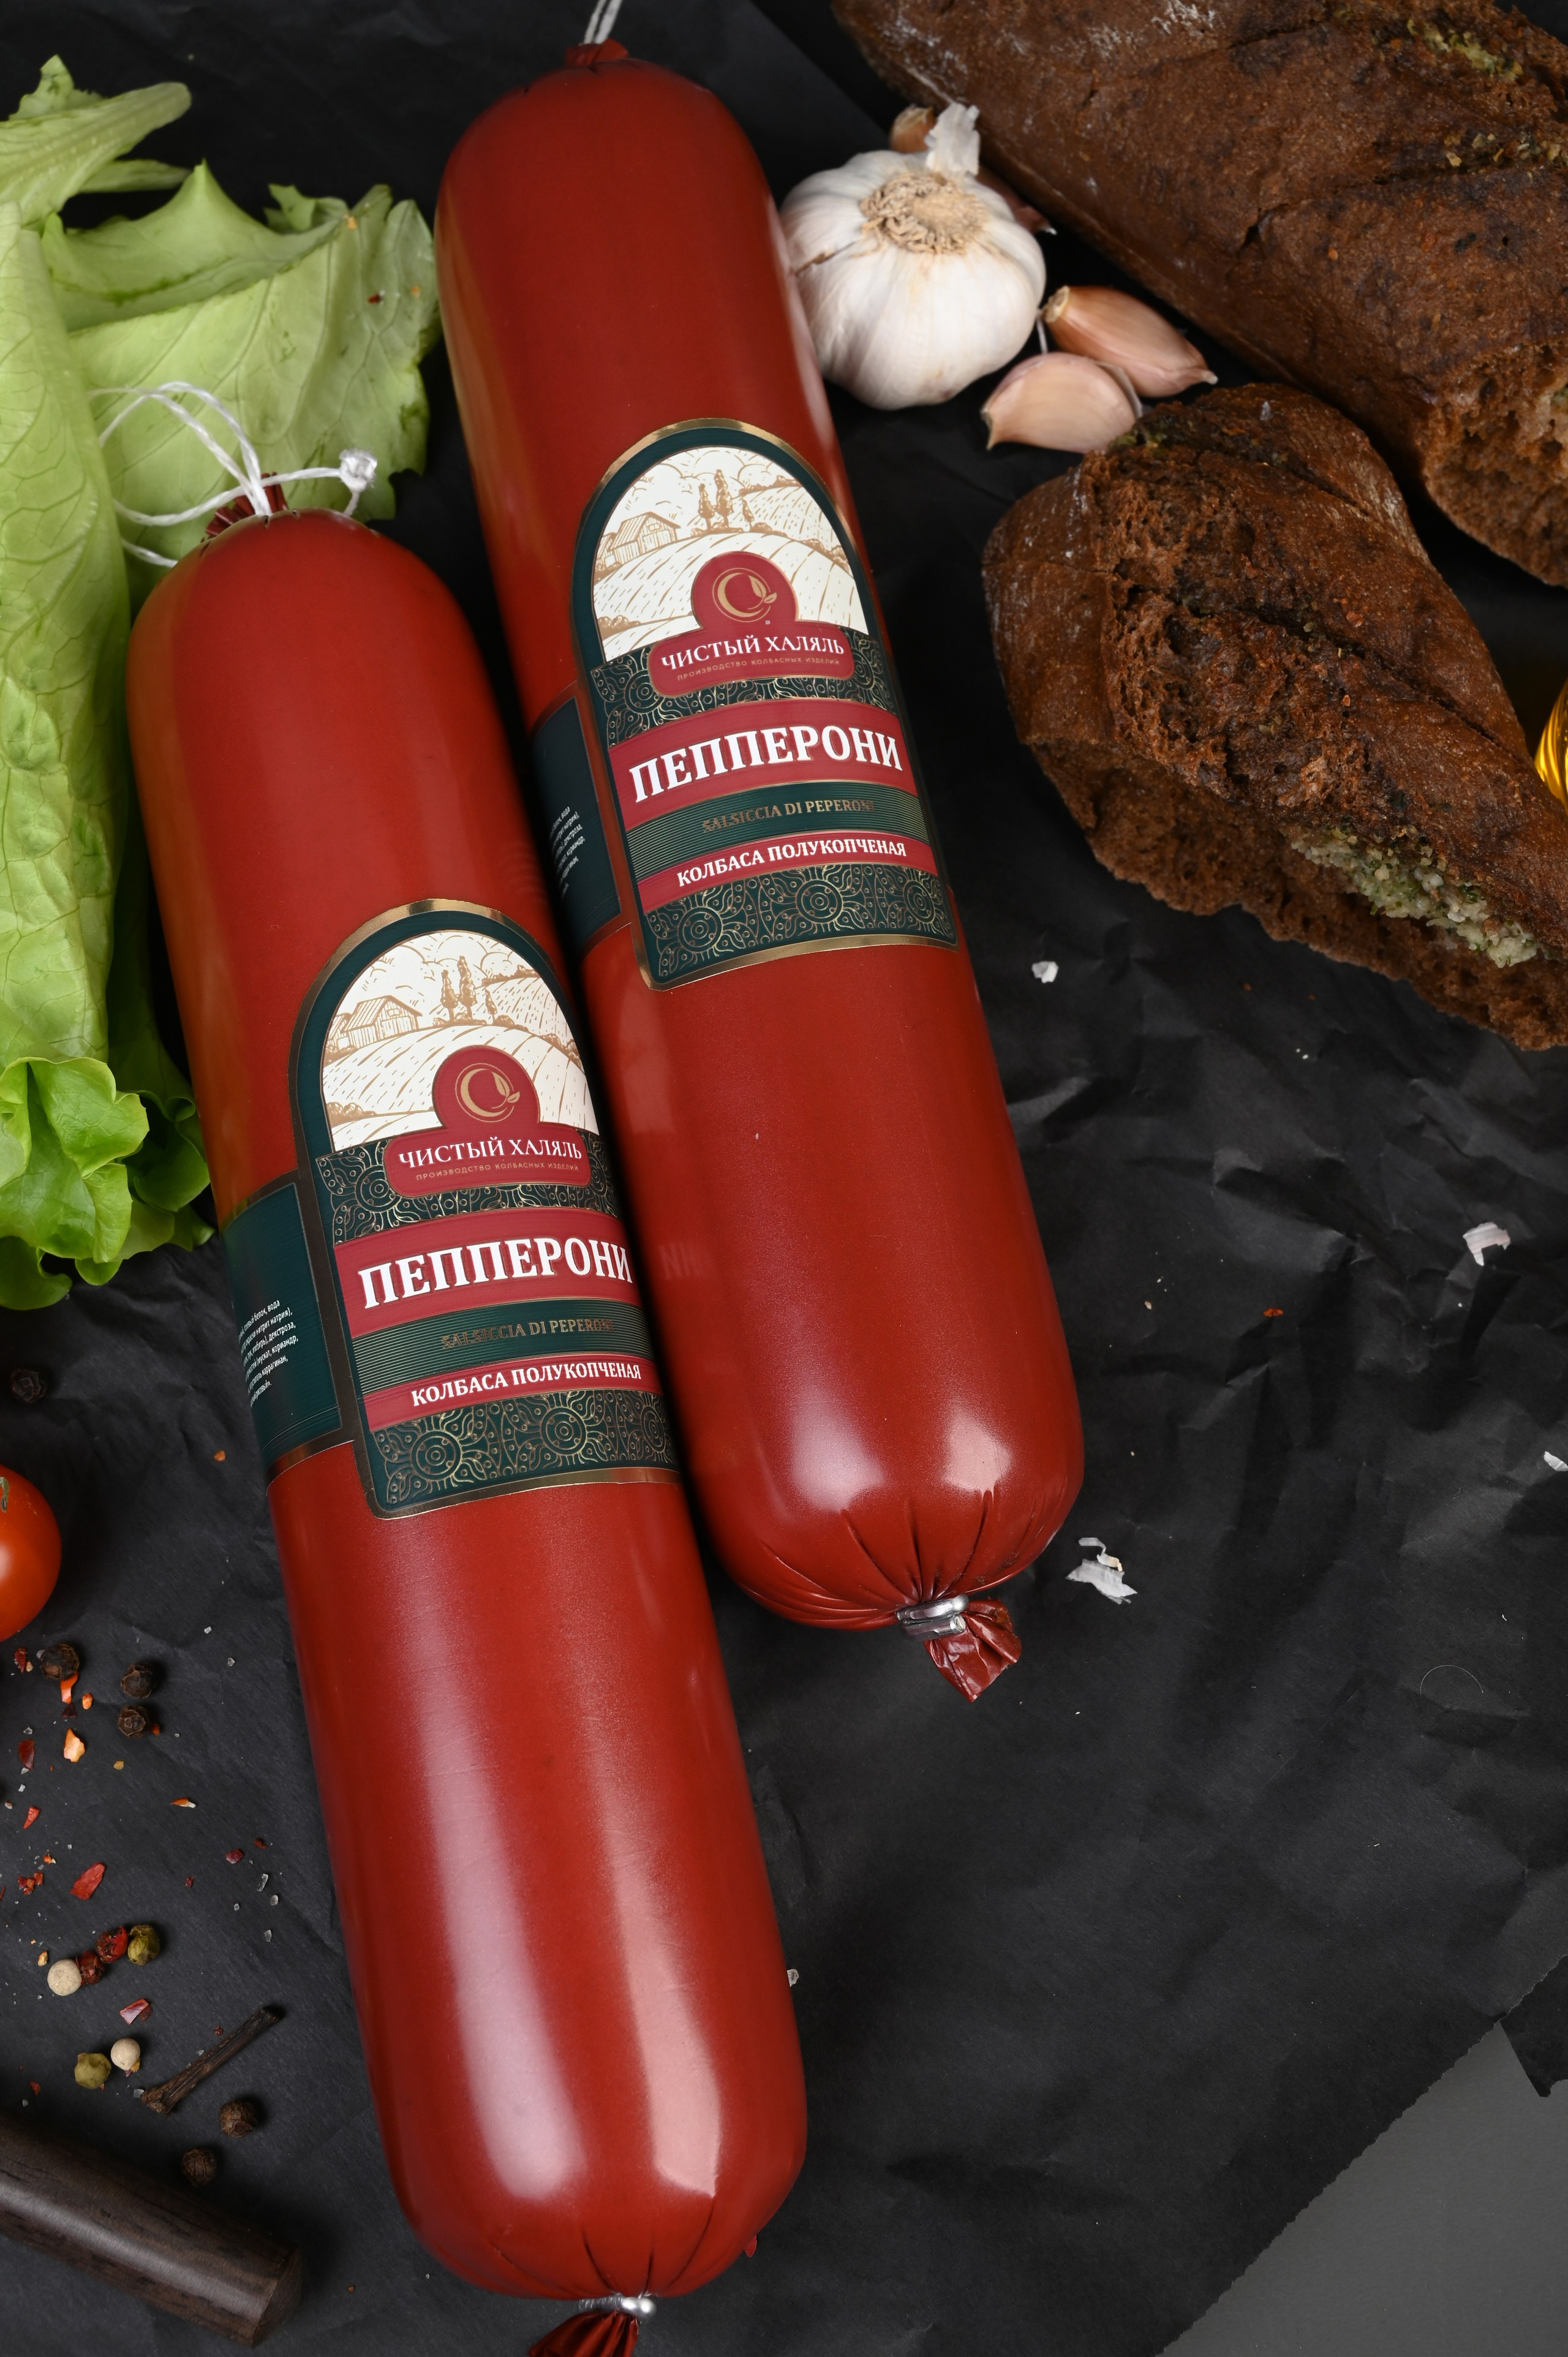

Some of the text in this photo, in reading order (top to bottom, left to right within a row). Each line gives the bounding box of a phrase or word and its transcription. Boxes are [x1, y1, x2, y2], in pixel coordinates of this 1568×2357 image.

[662, 635, 845, 670] ЧИСТЫЙ ХАЛЯЛЬ
[677, 660, 747, 681] ПРОИЗВОДСТВО
[629, 725, 903, 803] ПЕППЕРОНИ
[703, 805, 782, 832] SALSICCIA
[785, 802, 802, 815] DI
[677, 839, 907, 887] КОЛБАСА ПОЛУКОПЧЕНАЯ
[398, 1136, 582, 1168] ЧИСТЫЙ ХАЛЯЛЬ
[416, 1164, 491, 1180] ПРОИЗВОДСТВО
[358, 1237, 633, 1309] ПЕППЕРОНИ
[267, 1300, 281, 1312] вода
[270, 1307, 293, 1325] натрия),
[268, 1321, 296, 1343] декстроза,
[271, 1335, 299, 1353] кориандр,
[441, 1324, 525, 1349] SALSICCIA
[529, 1321, 546, 1335] DI
[411, 1362, 642, 1406] КОЛБАСА ПОЛУКОПЧЕНАЯ
